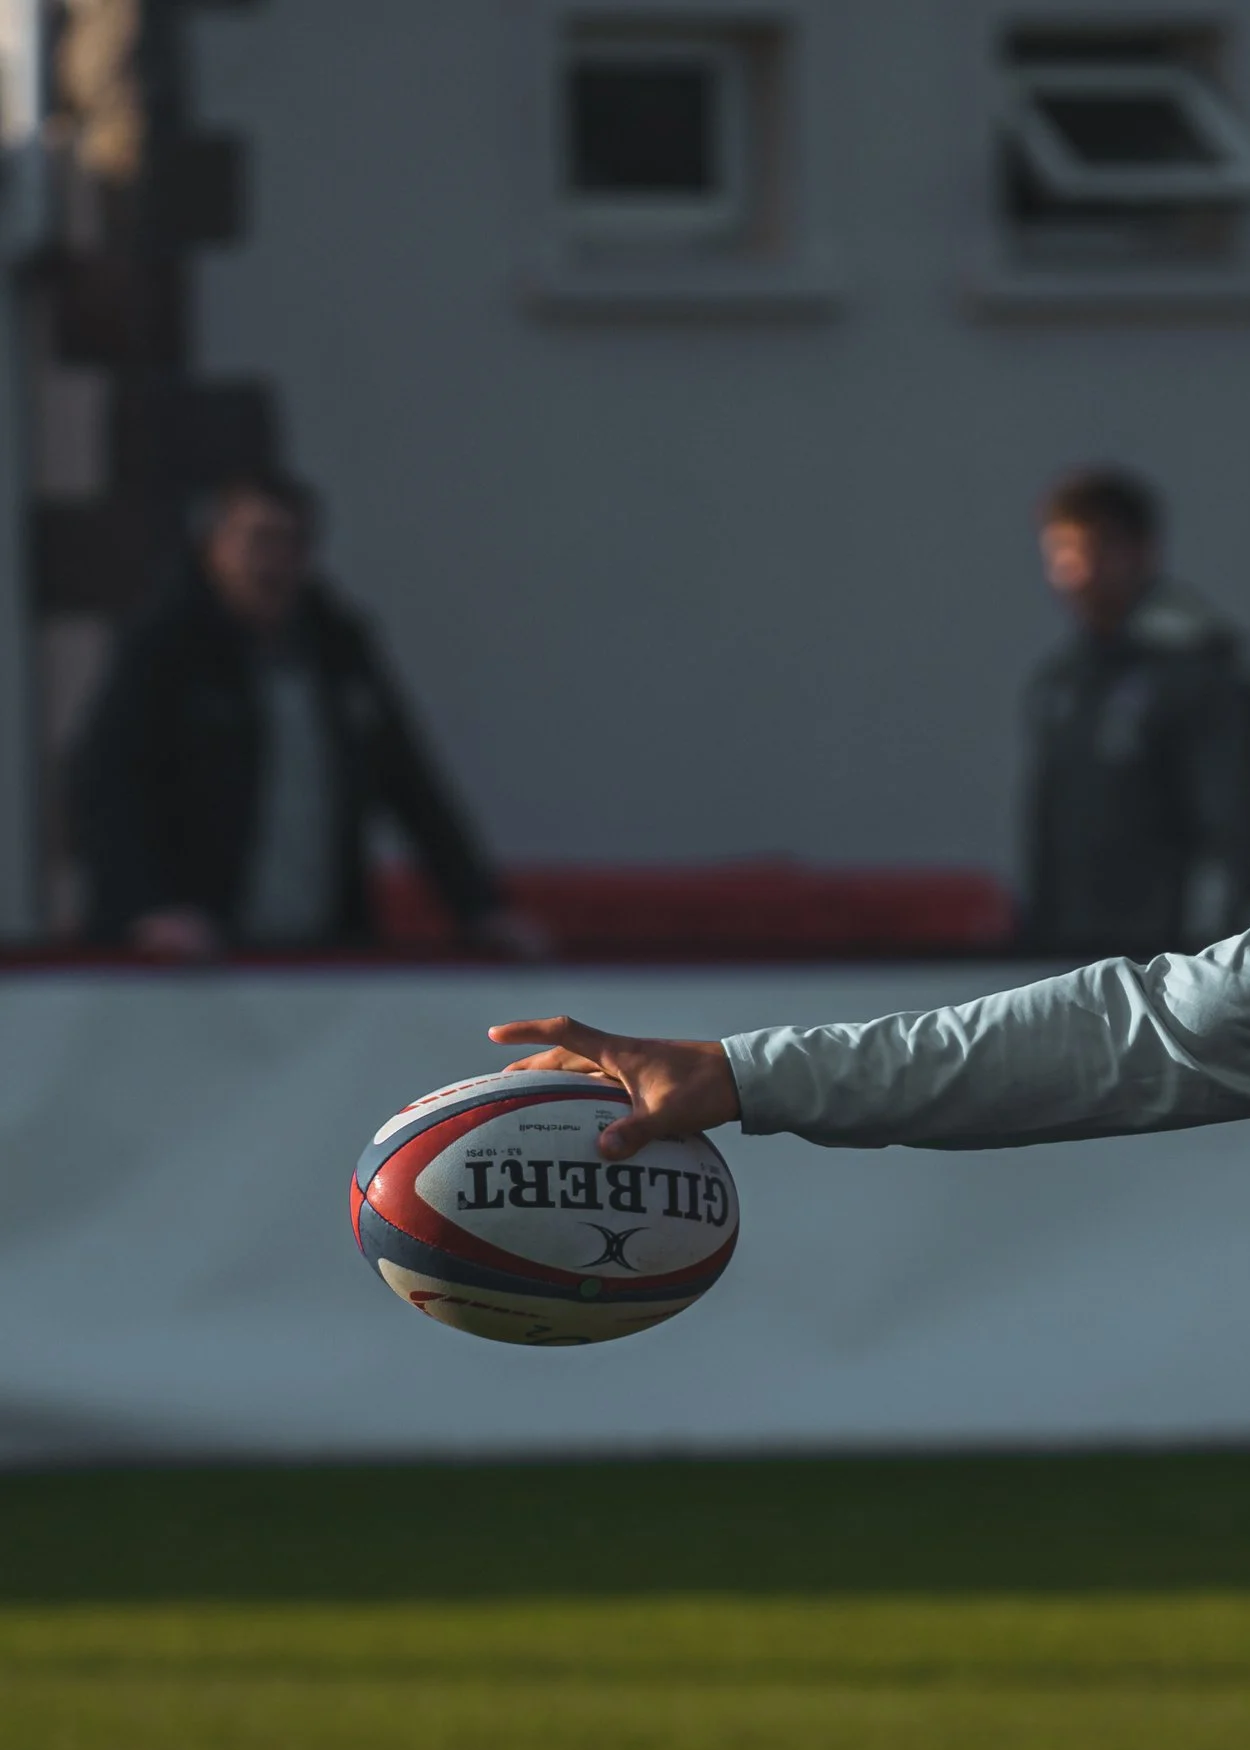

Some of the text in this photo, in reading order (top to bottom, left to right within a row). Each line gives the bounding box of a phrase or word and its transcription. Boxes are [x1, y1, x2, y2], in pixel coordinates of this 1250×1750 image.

[519, 1124, 581, 1132] matchball
[466, 1149, 484, 1158] PSI
[486, 1148, 498, 1157] 10
[458, 1159, 729, 1227] GILBERT
